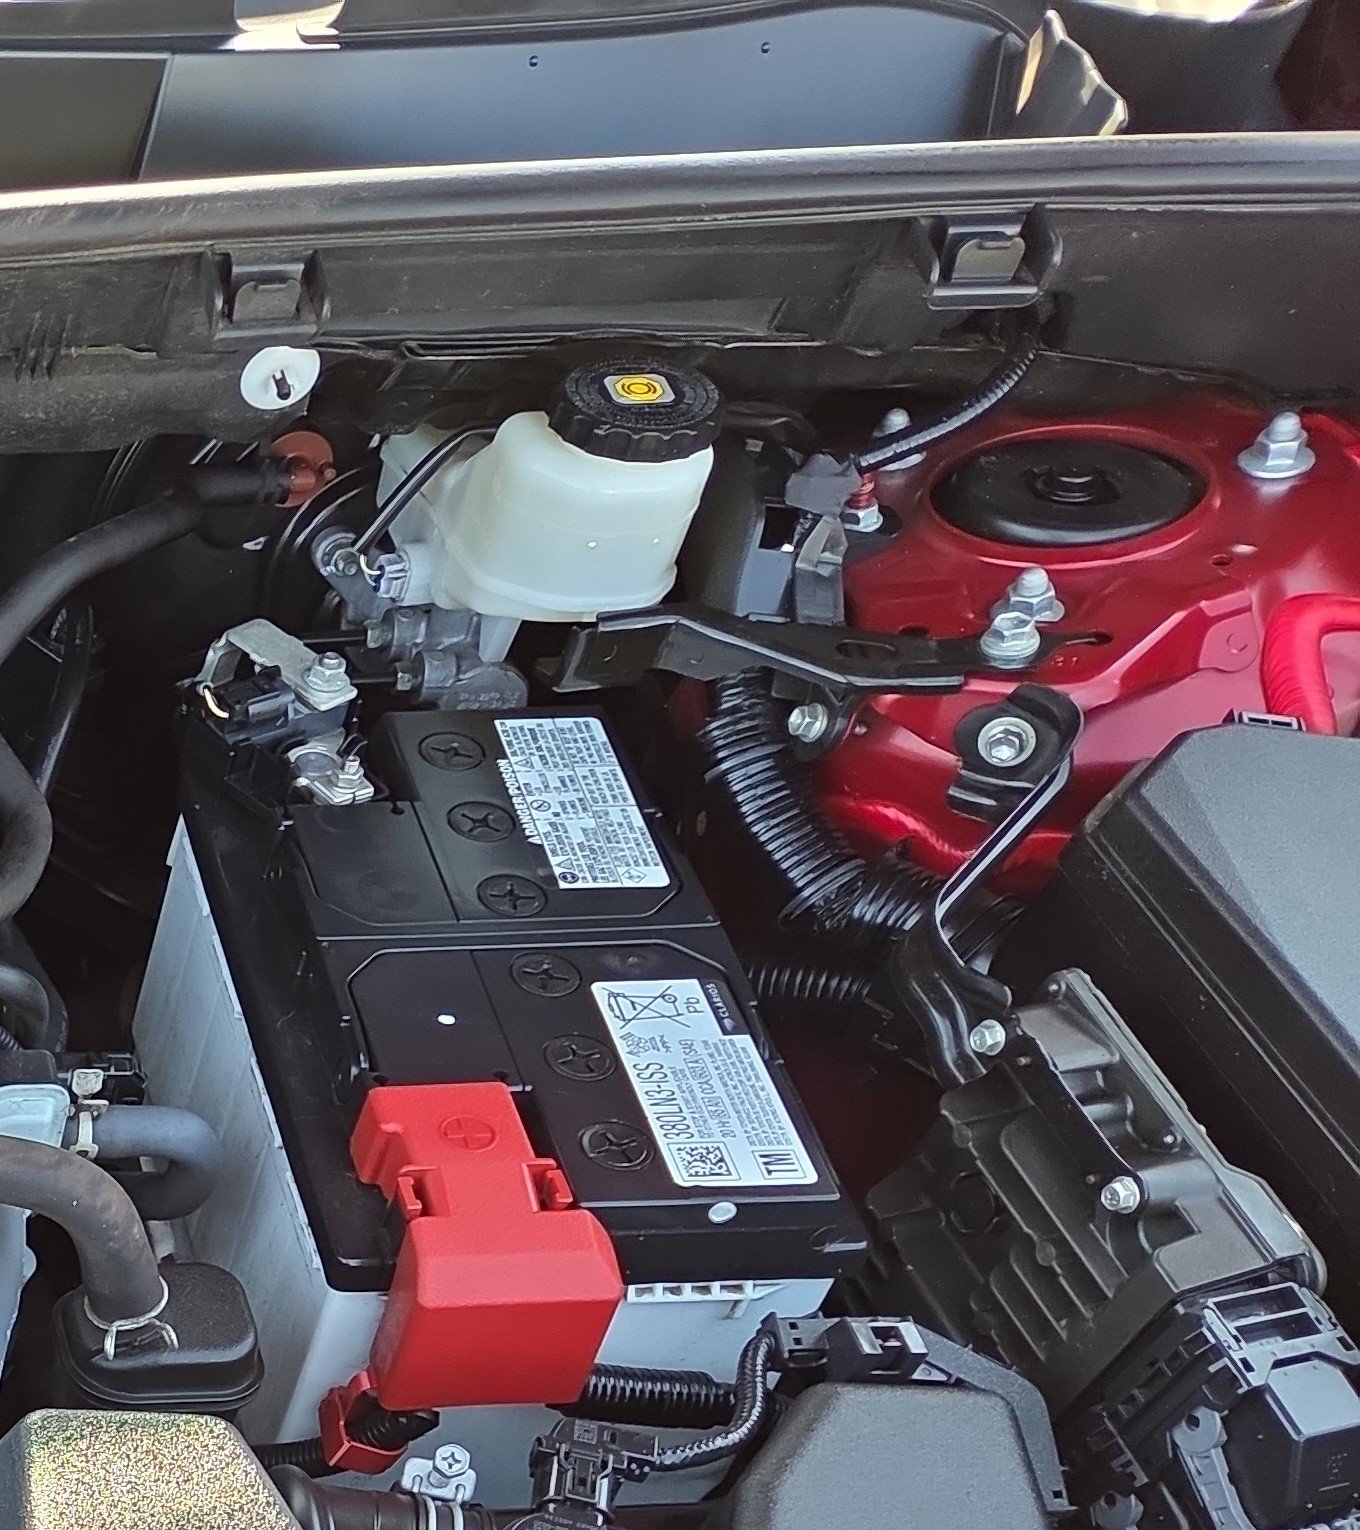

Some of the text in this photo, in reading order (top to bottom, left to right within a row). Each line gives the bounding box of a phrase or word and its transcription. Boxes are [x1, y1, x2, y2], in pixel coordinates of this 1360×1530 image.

[684, 997, 705, 1014] Pb
[633, 1061, 695, 1140] 380LN3-ISS
[761, 1154, 798, 1176] TM
